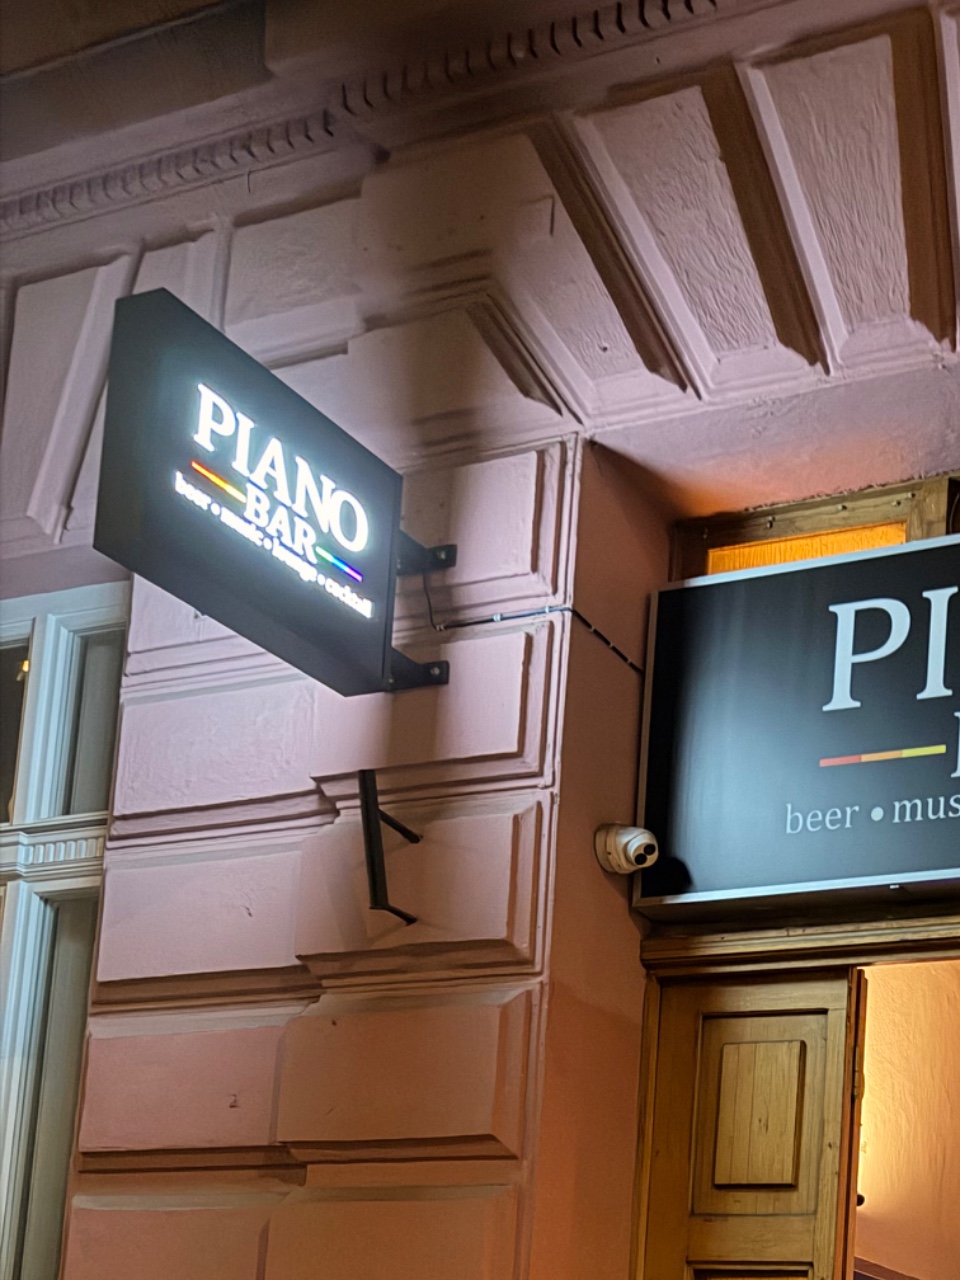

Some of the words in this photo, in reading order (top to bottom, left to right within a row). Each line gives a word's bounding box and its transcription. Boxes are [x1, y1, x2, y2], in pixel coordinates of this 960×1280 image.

[192, 383, 369, 552] PIANO
[243, 483, 318, 564] BAR
[785, 803, 861, 834] beer
